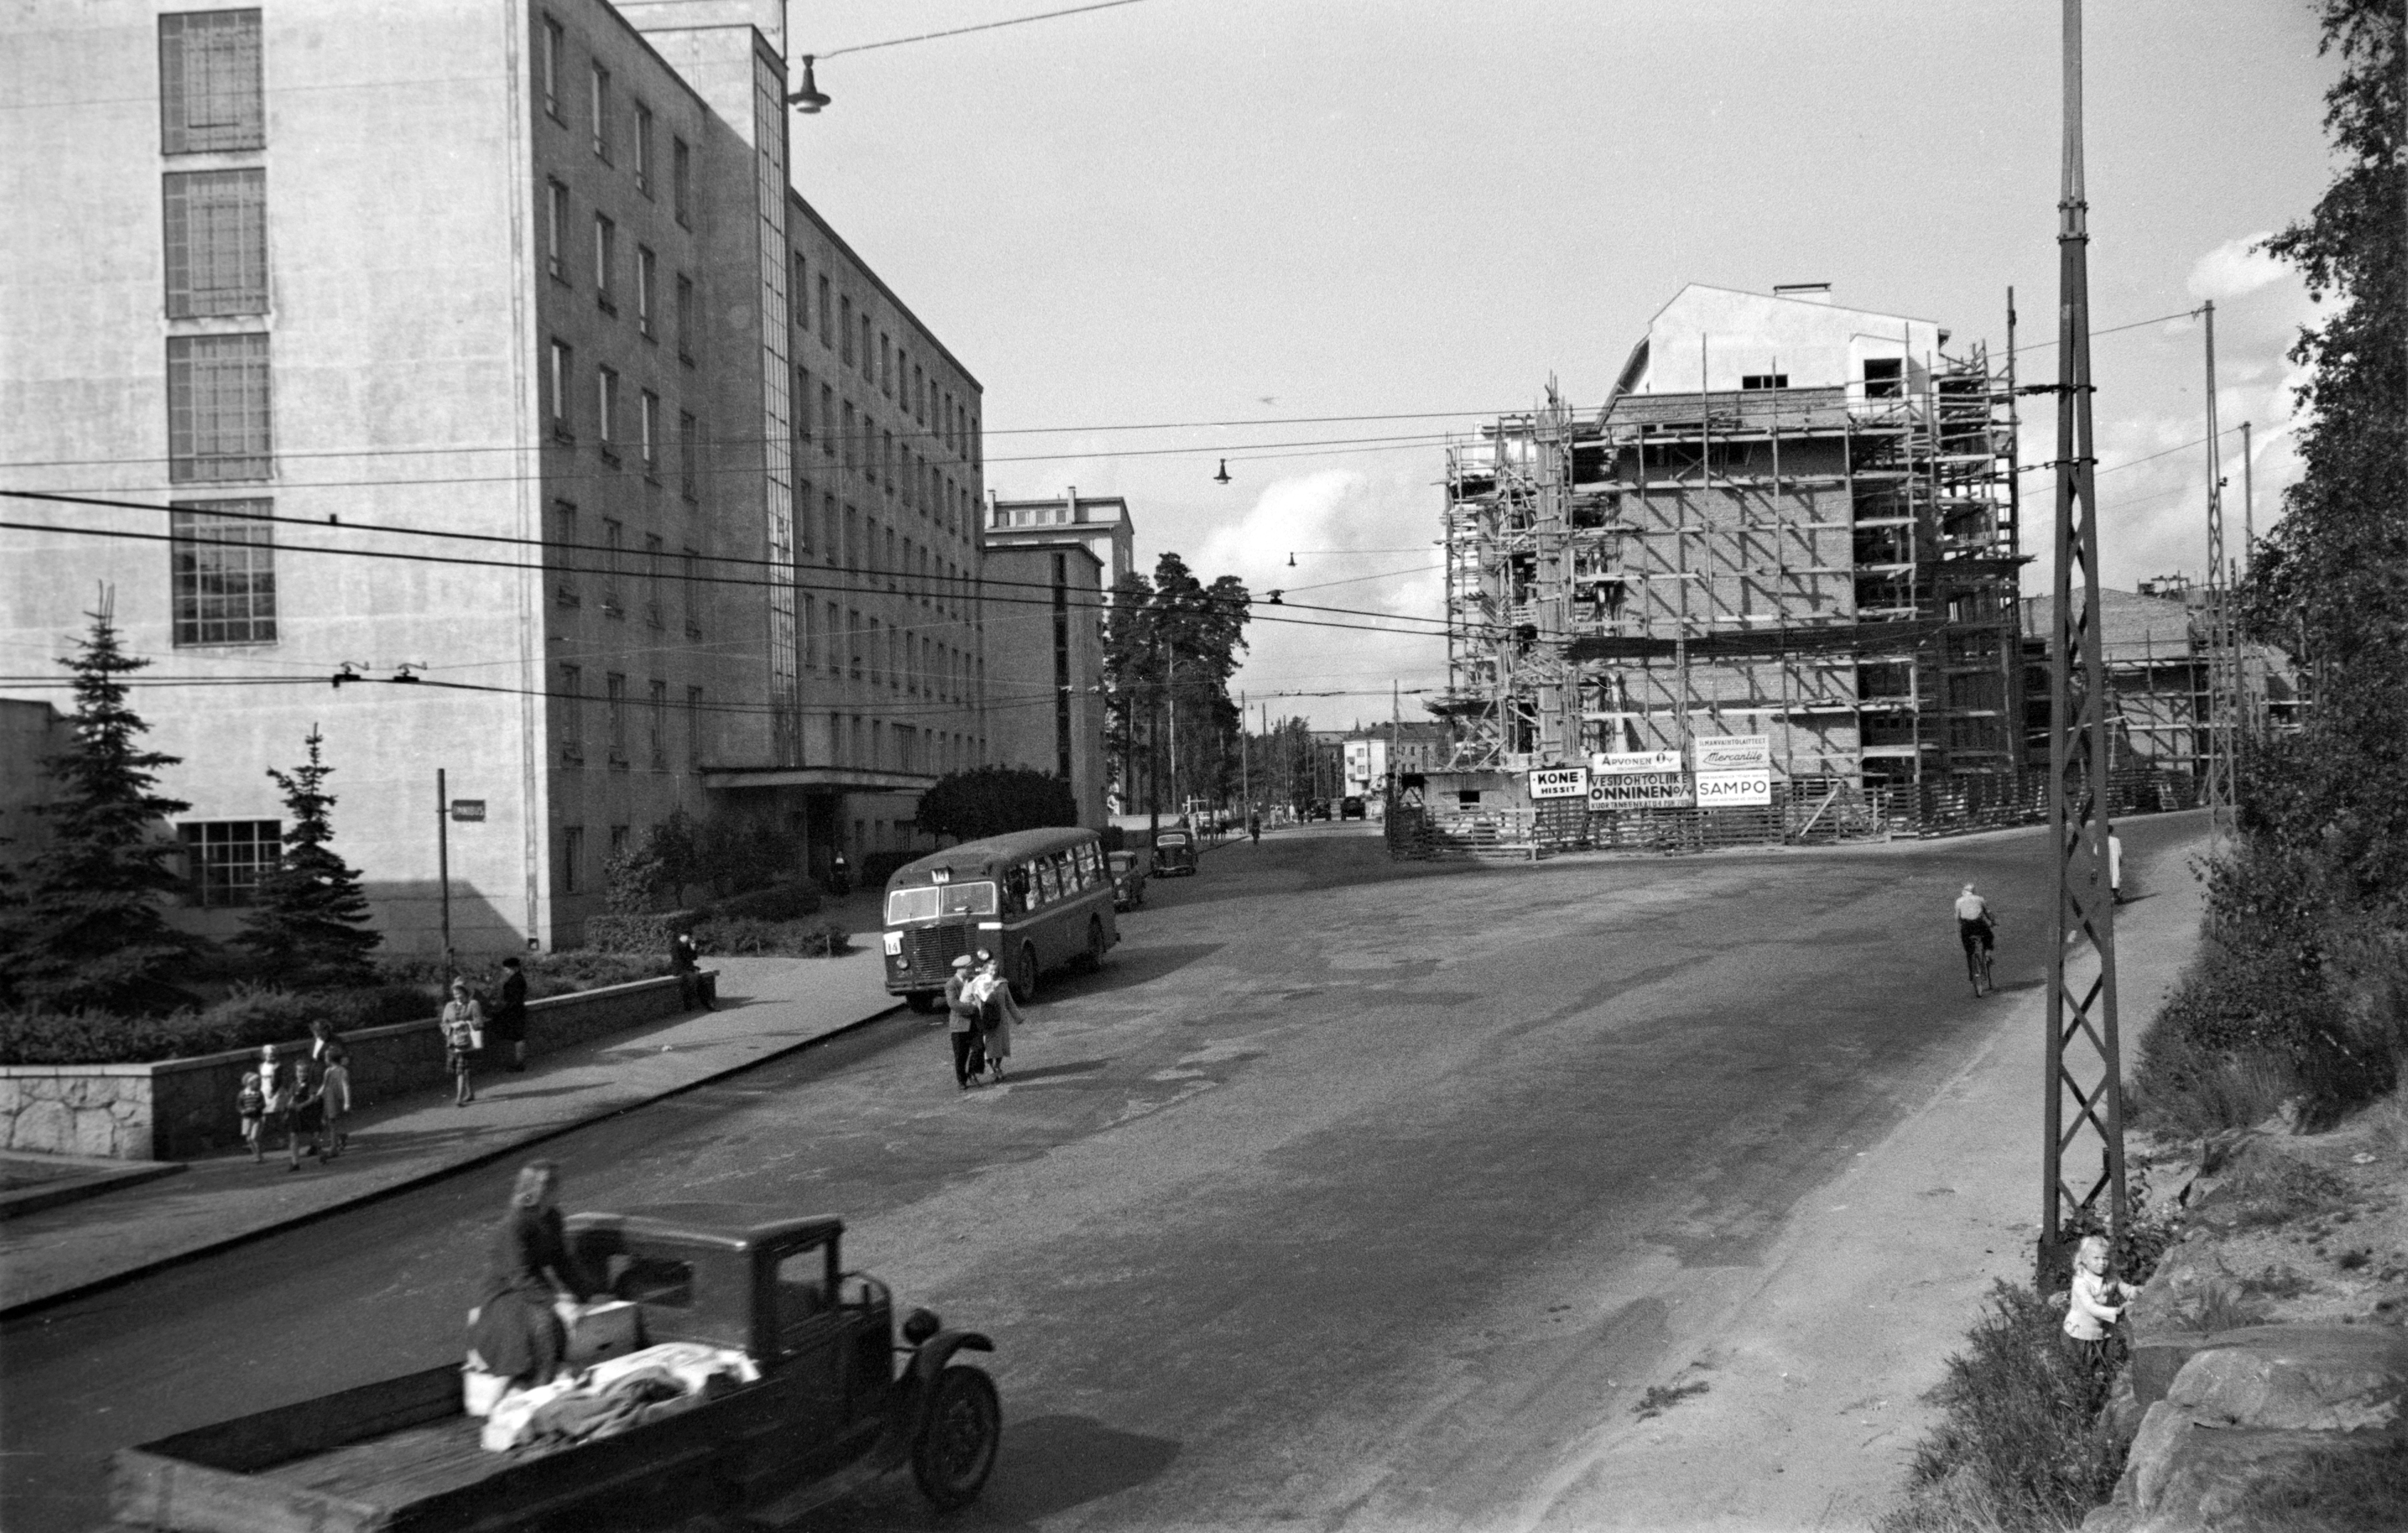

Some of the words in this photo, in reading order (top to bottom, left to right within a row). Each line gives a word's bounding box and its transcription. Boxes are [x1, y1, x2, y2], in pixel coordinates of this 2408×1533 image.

[1704, 751, 1762, 762] Mercantile
[1538, 772, 1578, 785] KONE
[1591, 774, 1688, 787] VESIJOHTOLIIKE
[1541, 786, 1576, 794] HISSIT
[1591, 785, 1672, 800] ONNINEN
[1699, 780, 1767, 795] SAMPO
[888, 943, 898, 953] 14
